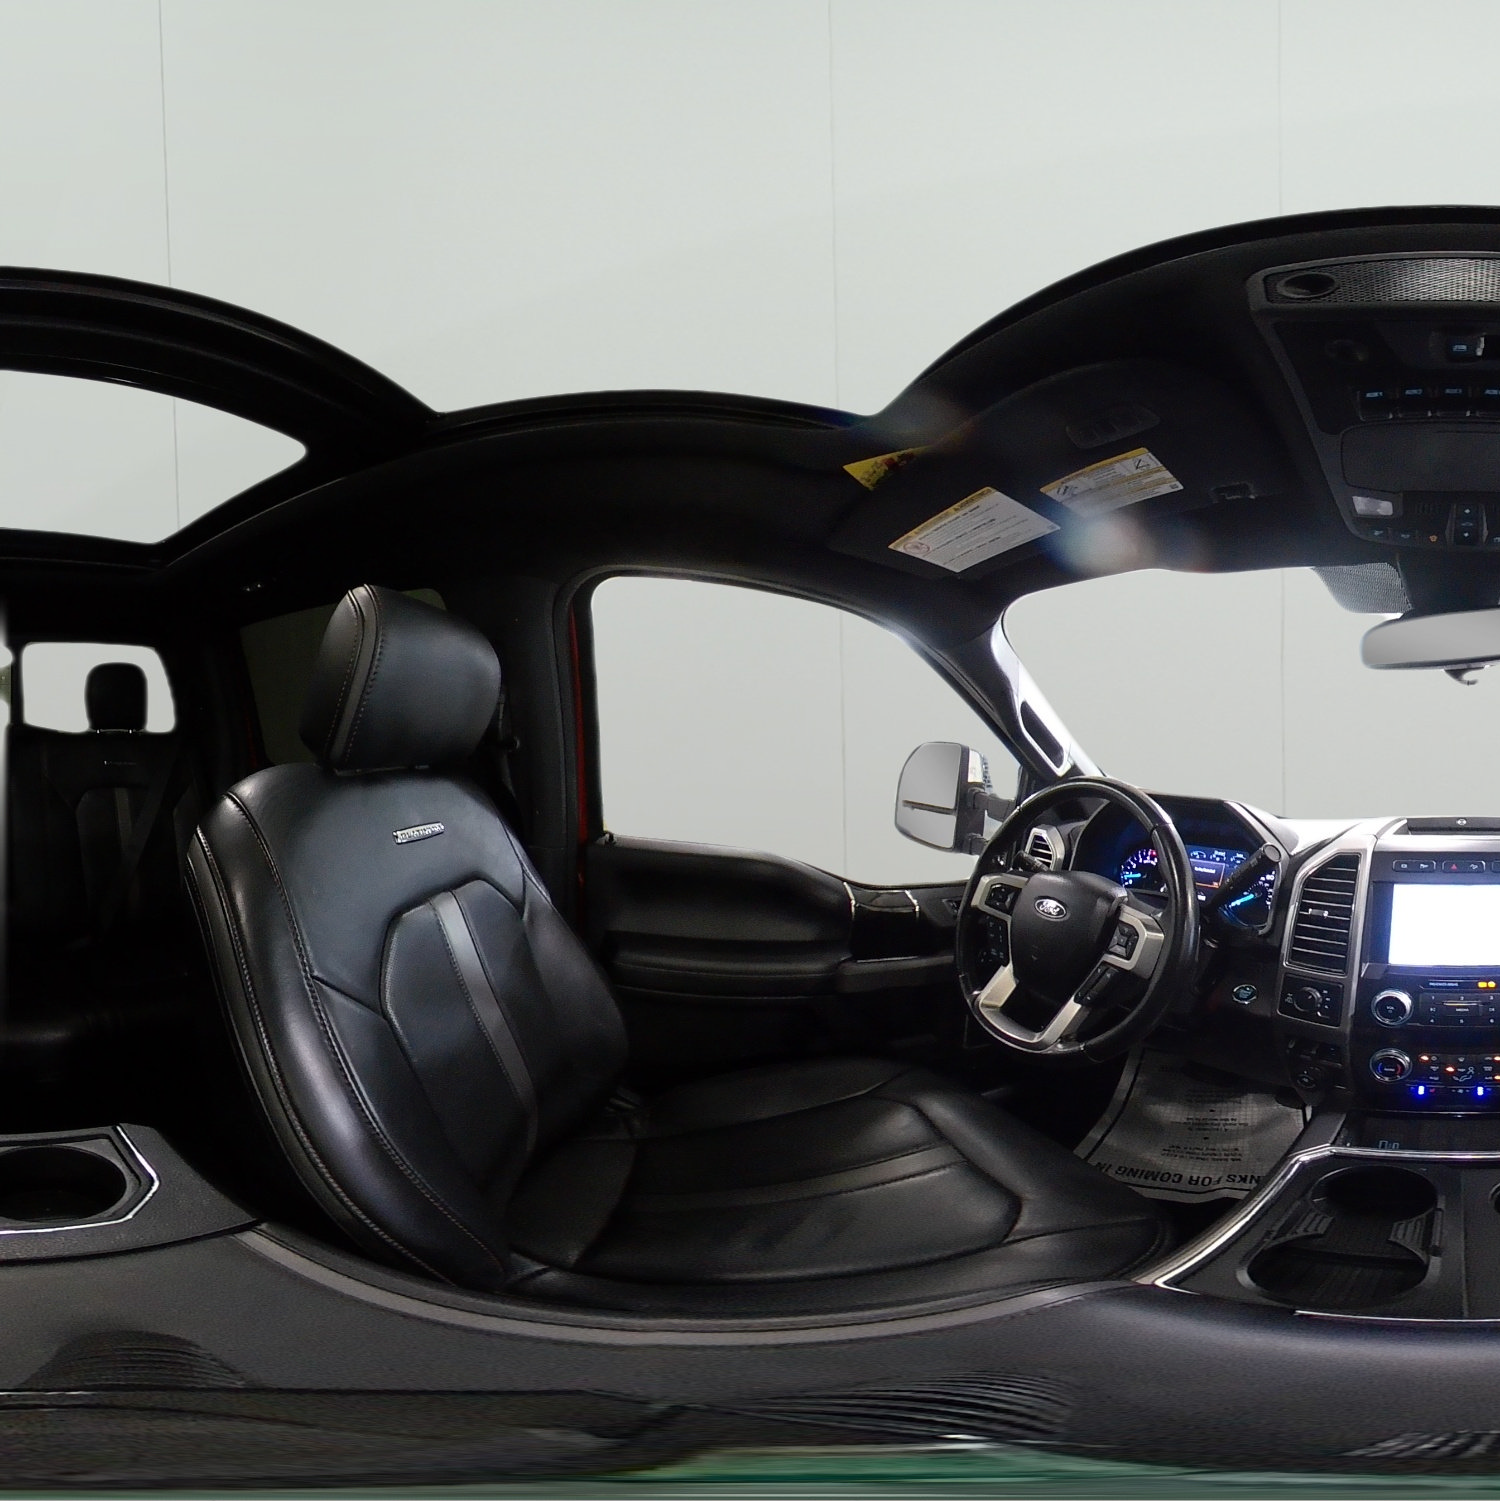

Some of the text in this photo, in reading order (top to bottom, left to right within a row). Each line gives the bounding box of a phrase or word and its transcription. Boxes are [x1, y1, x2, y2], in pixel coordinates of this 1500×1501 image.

[1038, 899, 1062, 916] Ford
[1115, 1165, 1183, 1184] COMING
[1188, 1175, 1222, 1187] FOR
[1226, 1174, 1260, 1185] NKS
